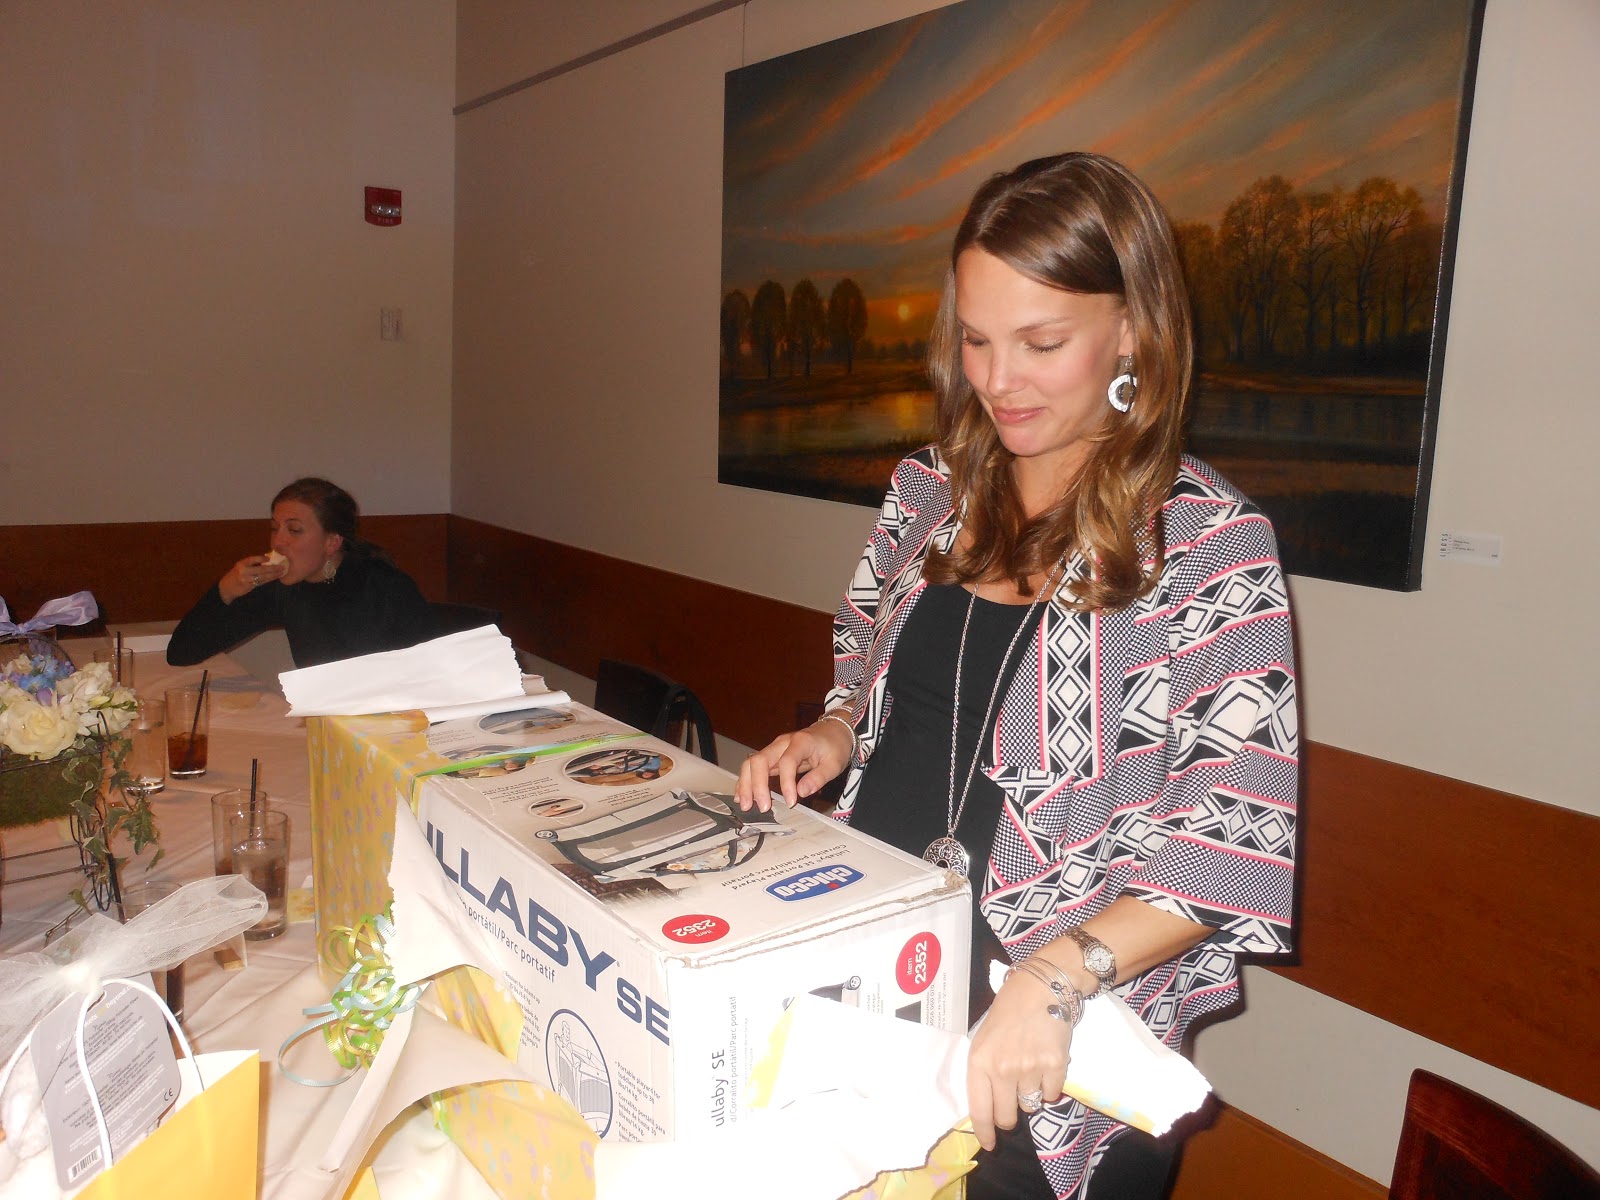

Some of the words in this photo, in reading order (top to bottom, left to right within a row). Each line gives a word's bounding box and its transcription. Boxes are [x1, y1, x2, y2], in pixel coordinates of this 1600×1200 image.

[721, 871, 755, 887] portatif
[732, 876, 766, 890] Playard
[766, 864, 803, 879] Portable
[773, 866, 853, 898] chicco
[426, 820, 616, 992] LLABY
[617, 977, 670, 1046] SE
[672, 919, 716, 937] 2352
[695, 929, 713, 938] item
[520, 949, 556, 983] portatif
[915, 940, 927, 984] 2352
[729, 996, 738, 1026] portatif
[712, 1049, 724, 1070] SE
[618, 1062, 636, 1080] Portable
[636, 1078, 654, 1095] playard
[618, 1092, 638, 1112] Corralito
[711, 1079, 728, 1127] ullaby
